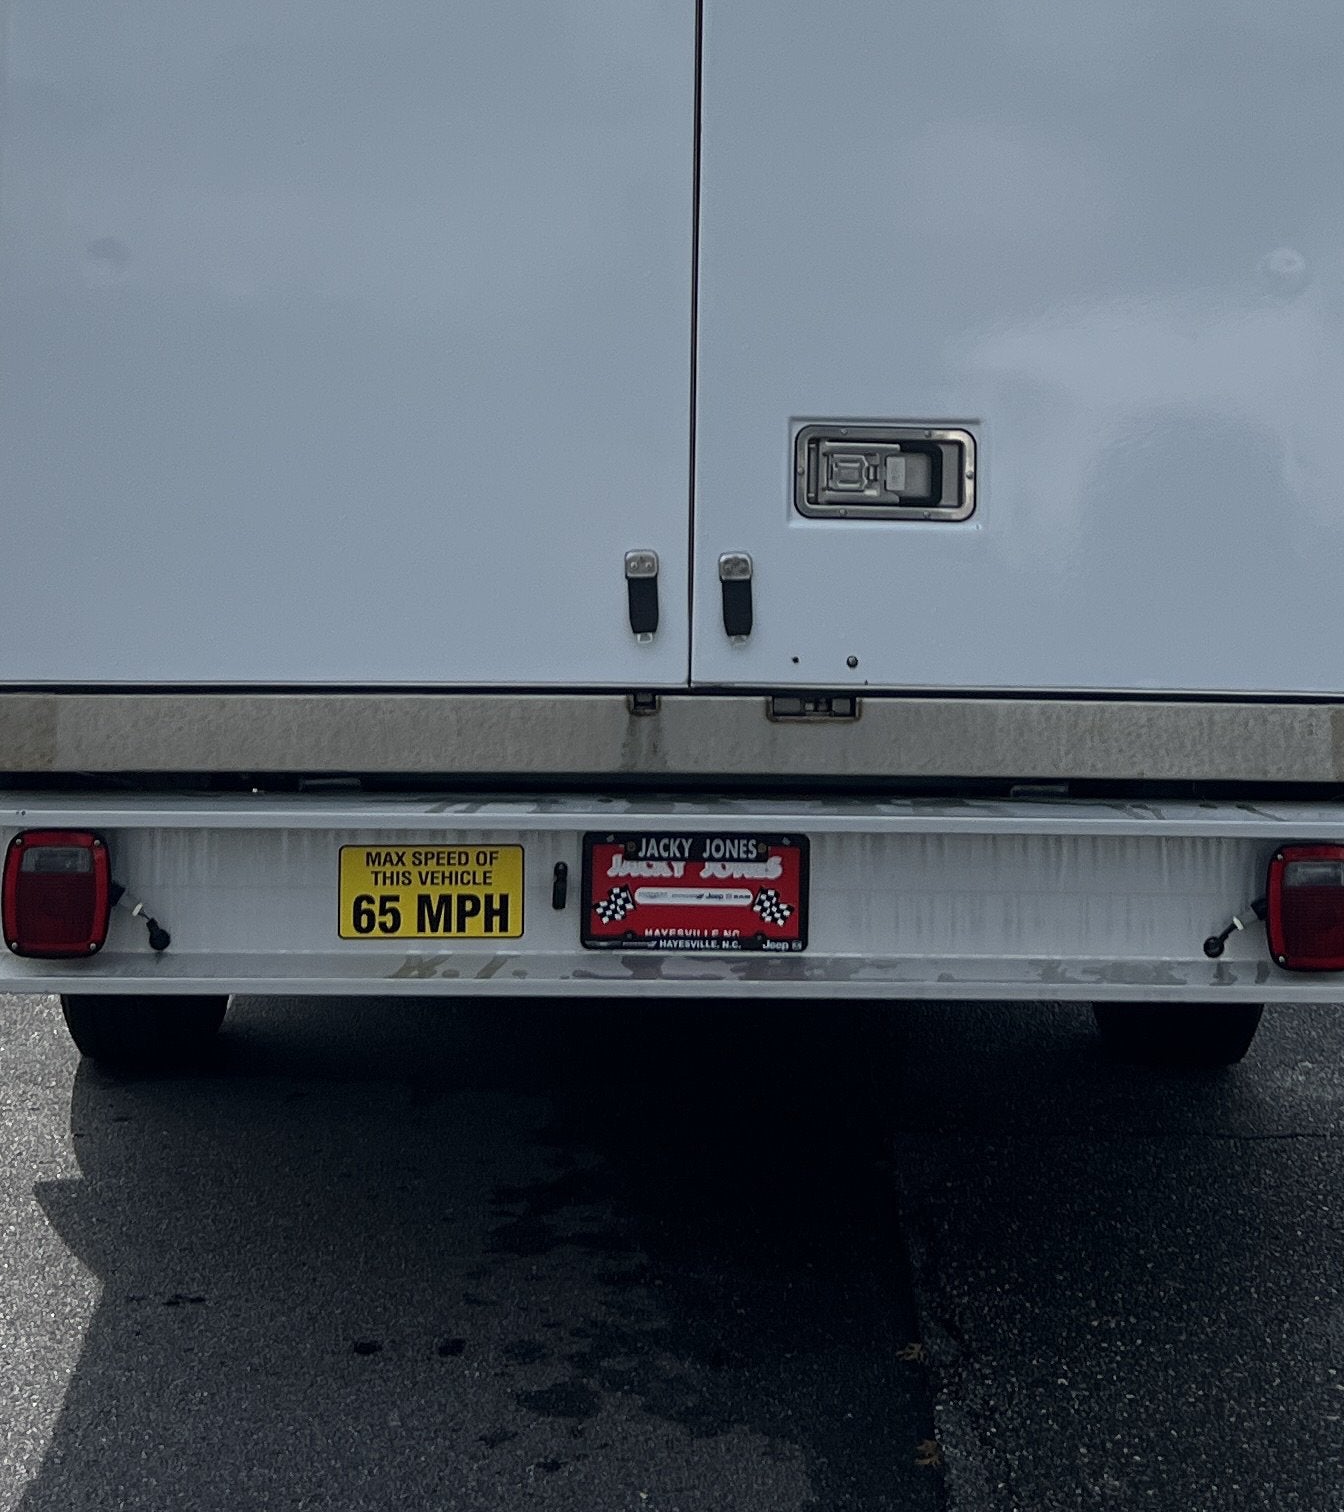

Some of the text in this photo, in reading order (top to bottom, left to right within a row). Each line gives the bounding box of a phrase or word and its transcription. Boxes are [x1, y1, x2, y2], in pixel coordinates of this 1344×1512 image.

[638, 838, 757, 860] JACKY JONES
[366, 850, 499, 867] MAX SPEED OF
[371, 870, 493, 886] THIS VEHICLE
[353, 893, 509, 934] 65 MPH
[762, 939, 789, 952] Jeep
